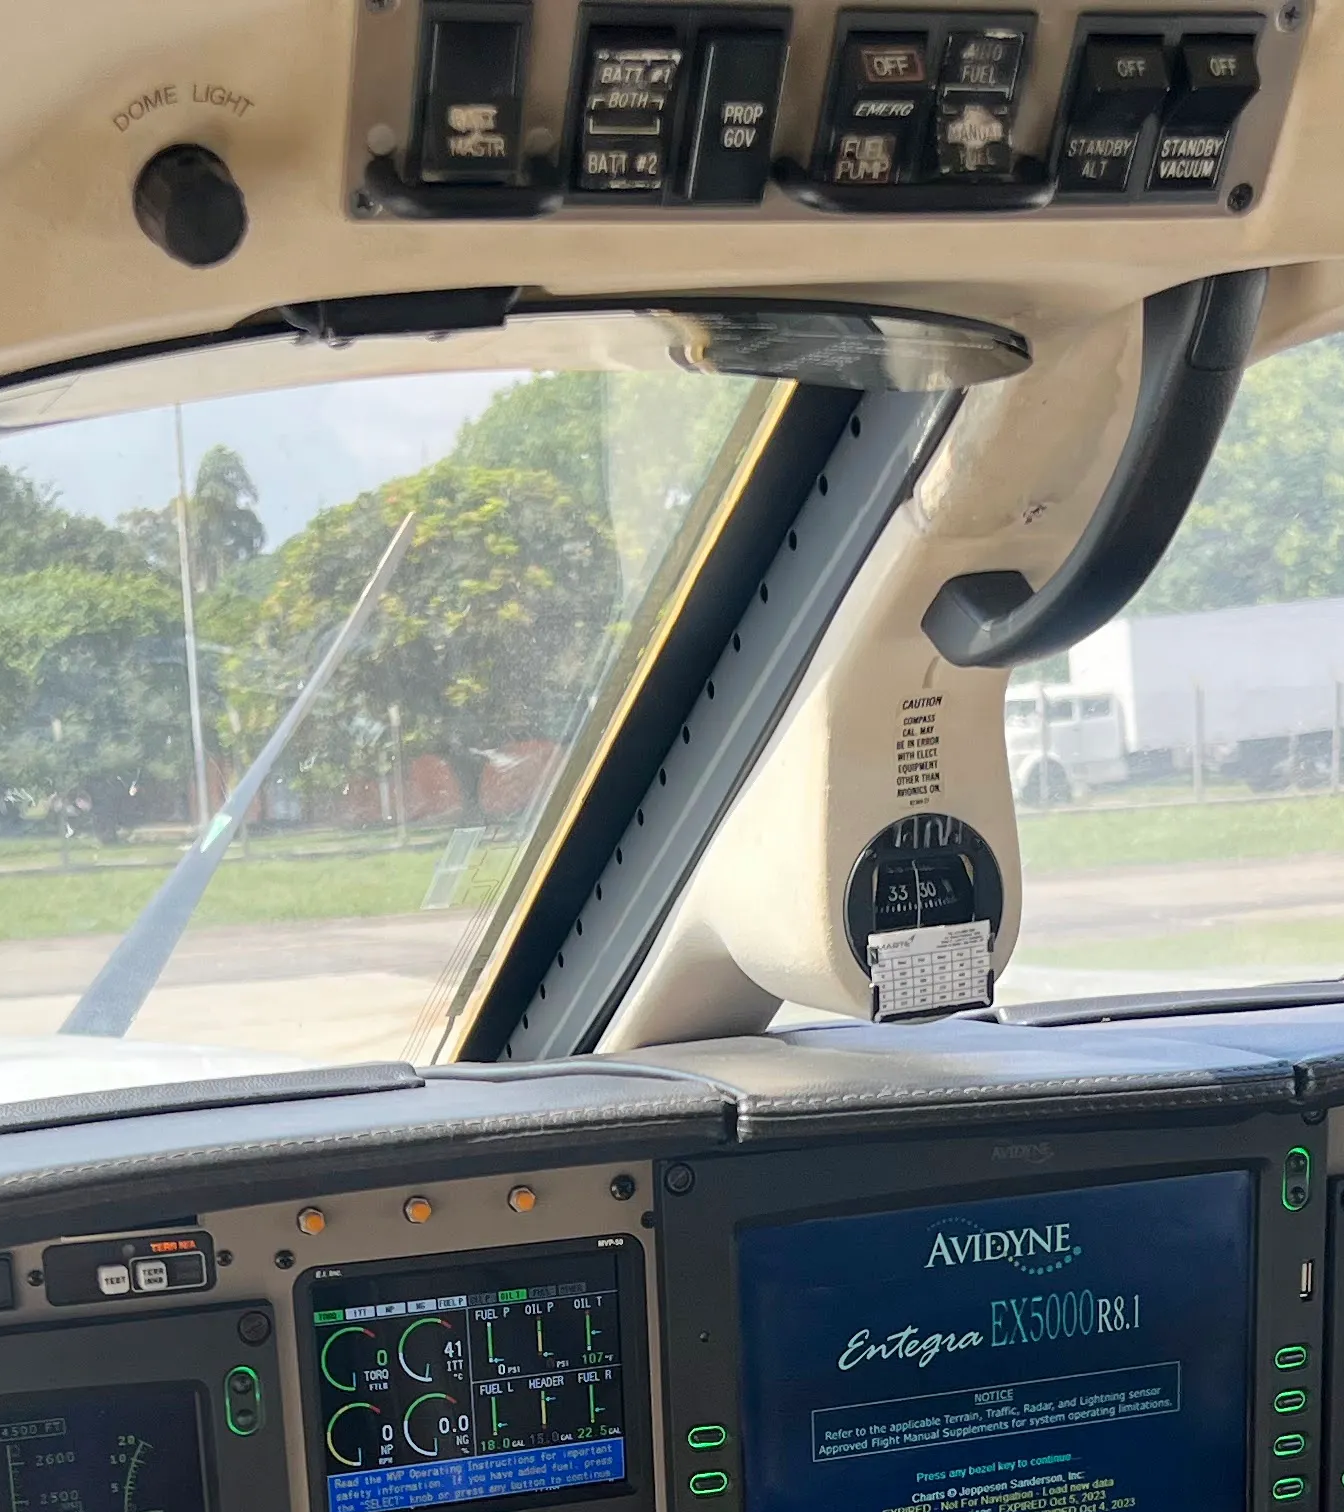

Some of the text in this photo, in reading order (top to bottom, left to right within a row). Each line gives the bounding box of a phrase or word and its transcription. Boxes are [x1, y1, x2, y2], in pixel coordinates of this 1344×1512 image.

[873, 55, 909, 77] OFF
[961, 64, 997, 85] FUEL
[1116, 57, 1146, 78] OFF
[1209, 57, 1237, 77] OFF
[601, 67, 644, 84] BATT
[113, 84, 254, 133] DOME LIGHT
[608, 92, 648, 109] BOTH
[724, 103, 764, 124] PROP
[855, 102, 915, 117] EMERG
[723, 127, 756, 148] GOV
[1068, 137, 1133, 157] STANDBY
[1160, 137, 1224, 157] STANDBY
[588, 153, 628, 175] BATT
[1081, 160, 1108, 179] ALT
[1159, 159, 1215, 179] VACUUM
[903, 696, 943, 710] CAUTION
[903, 714, 936, 726] COMPASS
[898, 760, 938, 774] EQUIPMENT
[897, 772, 940, 786] OTHER THAN
[888, 881, 937, 902] 33 30
[923, 1222, 1071, 1268] AVIDYNE
[525, 1303, 543, 1315] OIL
[573, 1298, 592, 1309] OIL
[475, 1309, 499, 1321] FUEL
[837, 1289, 1140, 1371] Entegra EX5000 R8.1
[444, 1341, 463, 1358] 41
[446, 1360, 464, 1372] ITT
[582, 1352, 604, 1365] 107
[363, 1369, 389, 1381] TORQ
[528, 1375, 564, 1388] HEADER
[578, 1371, 601, 1384] FUEL
[480, 1384, 503, 1396] FUEL
[974, 1389, 1014, 1404] NOTICE
[825, 1387, 1161, 1441] Refer applicable Lightning sensor
[439, 1416, 469, 1434] 0.0
[577, 1425, 607, 1439] 22.5
[818, 1398, 1172, 1457] Approved Flight Manual Supplements system operating limitations.
[118, 1435, 135, 1446] 20
[480, 1437, 511, 1451] 18.0
[381, 1445, 394, 1456] NP
[916, 1462, 996, 1482] Press bezel
[912, 1481, 1007, 1504] Charts Jeppesen
[980, 1489, 1033, 1505] Navigation
[1092, 1477, 1114, 1488] data
[1081, 1490, 1106, 1502] 2023
[1112, 1497, 1136, 1509] 2023
